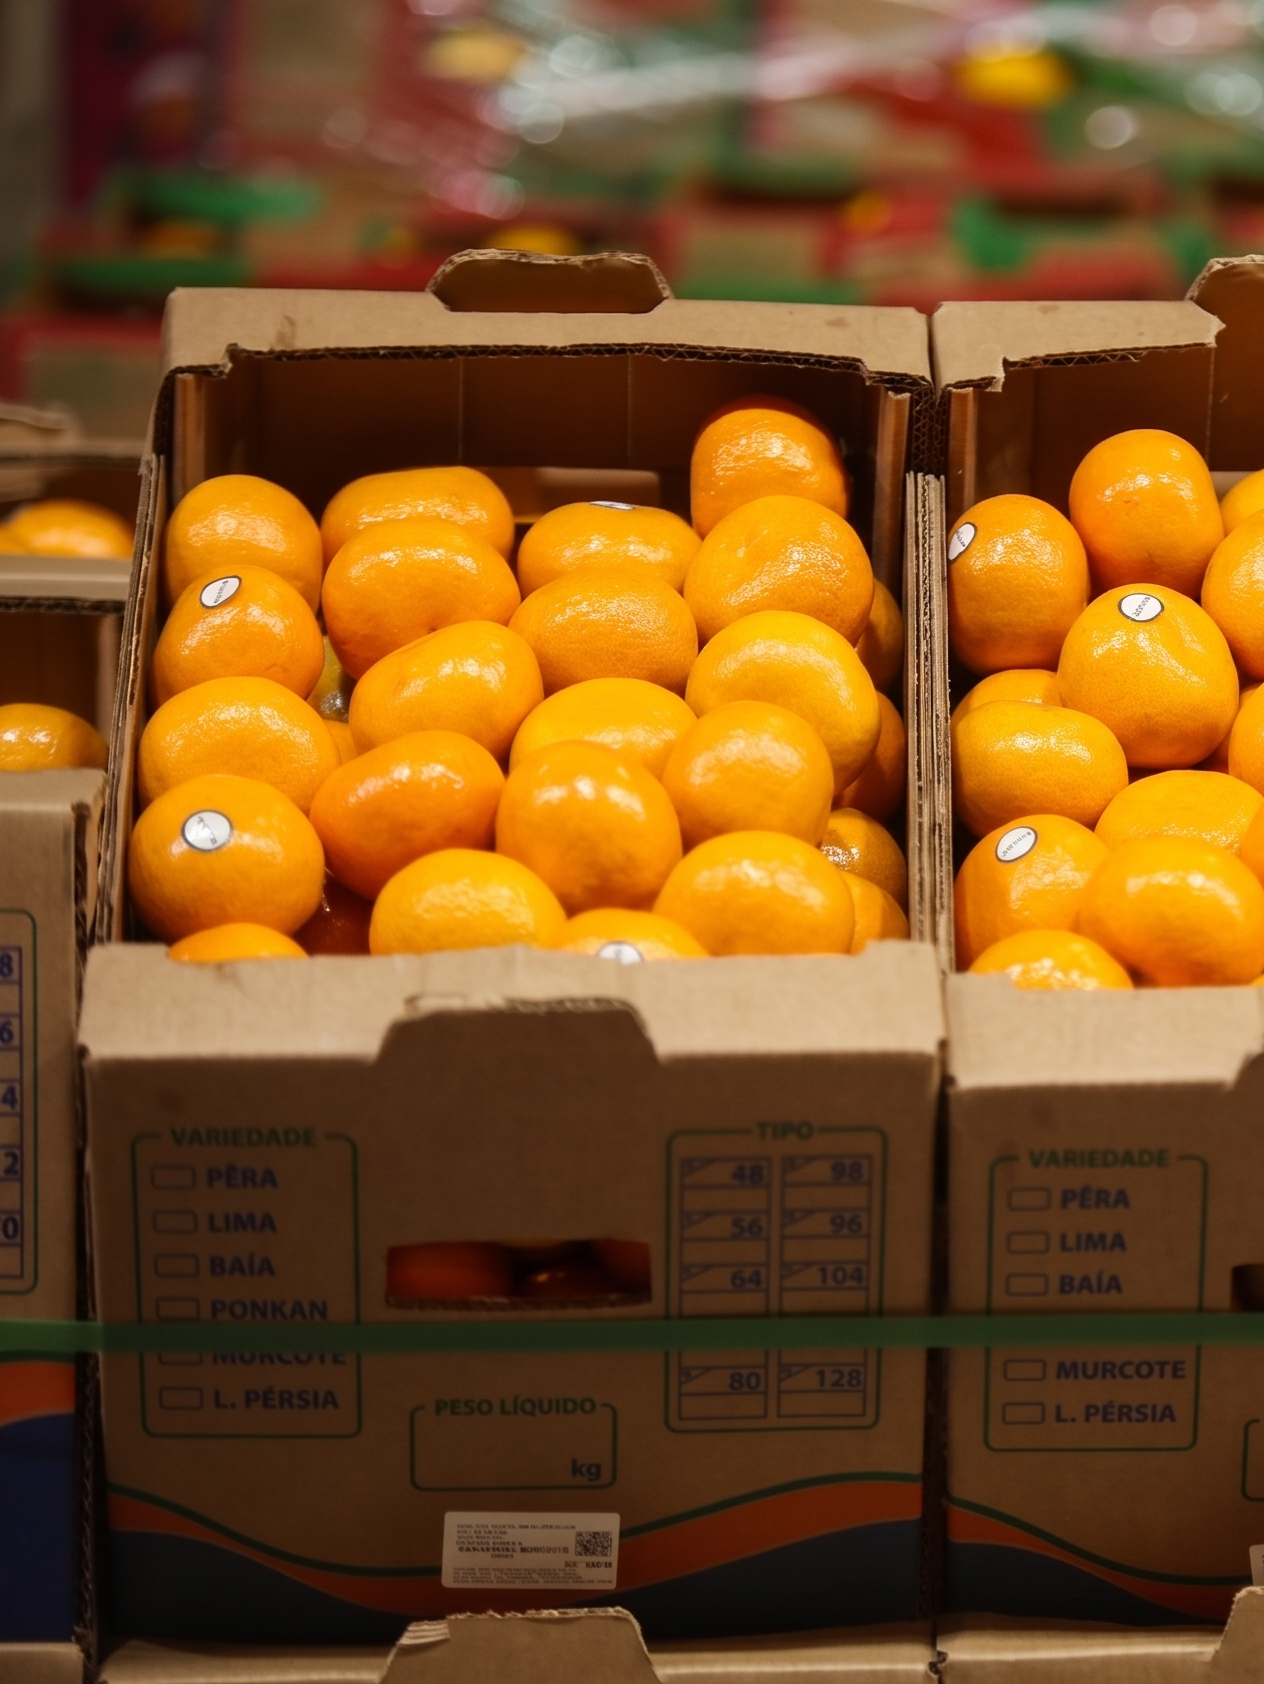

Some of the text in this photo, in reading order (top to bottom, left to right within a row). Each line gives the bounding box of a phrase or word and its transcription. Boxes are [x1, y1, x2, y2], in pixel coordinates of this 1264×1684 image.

[170, 1127, 316, 1147] VARIEDADE
[756, 1121, 814, 1141] TIPO
[1029, 1150, 1171, 1169] VARIEDADE
[207, 1163, 278, 1190] PÊRA
[731, 1163, 765, 1186] 48
[1060, 1183, 1131, 1211] PÊRA
[208, 1211, 278, 1234] LIMA
[731, 1216, 764, 1238] 56
[830, 1213, 863, 1235] 96
[1059, 1231, 1127, 1253] LIMA
[209, 1252, 276, 1278] BAÍA
[819, 1265, 864, 1286] 104
[730, 1269, 763, 1289] 64
[1058, 1269, 1123, 1295] BAÍA
[211, 1300, 329, 1321] PONKAN
[729, 1371, 762, 1391] 80
[816, 1368, 862, 1389] 128
[1055, 1360, 1187, 1381] MURCOTE
[214, 1385, 341, 1411] L. PÉRSIA
[434, 1394, 597, 1418] PESO LÍQUIDO
[1055, 1399, 1177, 1424] L. PÉRSIA
[571, 1458, 602, 1482] kg
